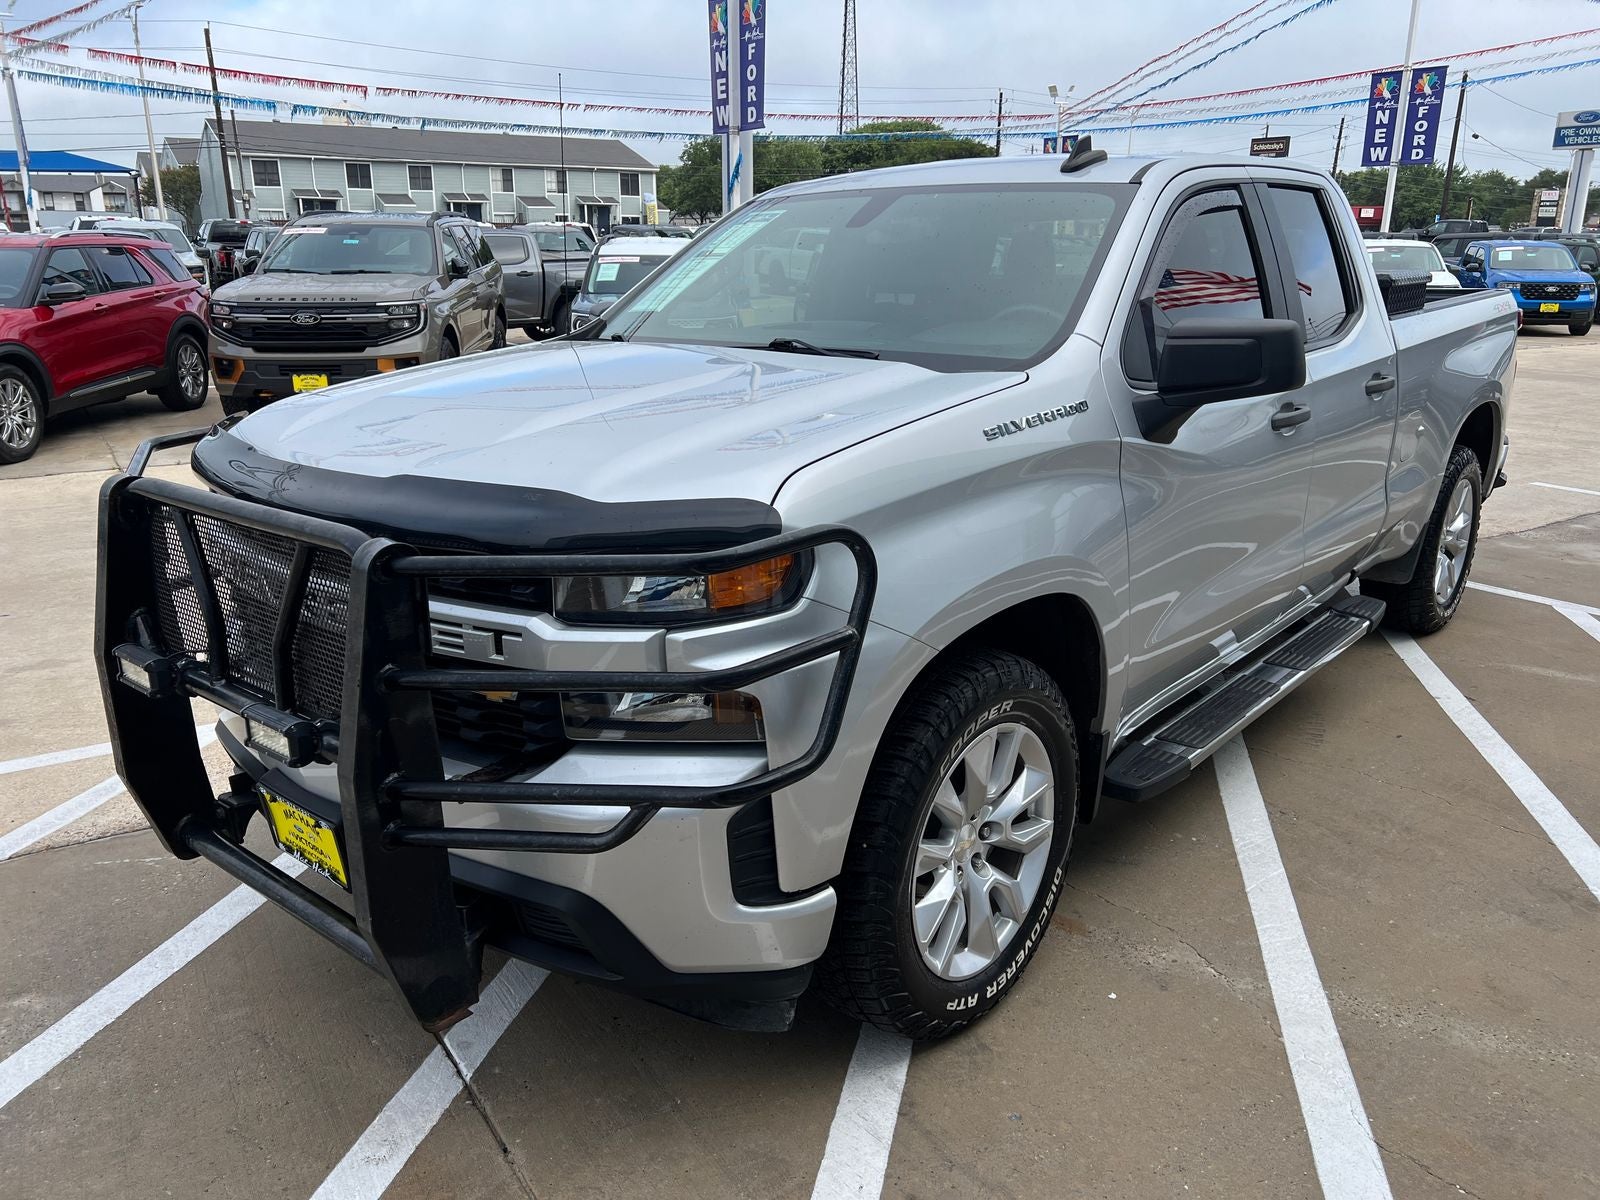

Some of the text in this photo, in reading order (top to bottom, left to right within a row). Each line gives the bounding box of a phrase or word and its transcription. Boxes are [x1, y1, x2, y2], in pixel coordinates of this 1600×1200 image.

[715, 50, 730, 126] NEW
[746, 42, 757, 123] FORD
[1370, 109, 1390, 162] NEW
[1411, 106, 1429, 160] FORD
[983, 399, 1089, 441] SILVERADO
[940, 699, 1014, 777] COOPER
[946, 866, 1063, 1011] DISCOVERER ATP
